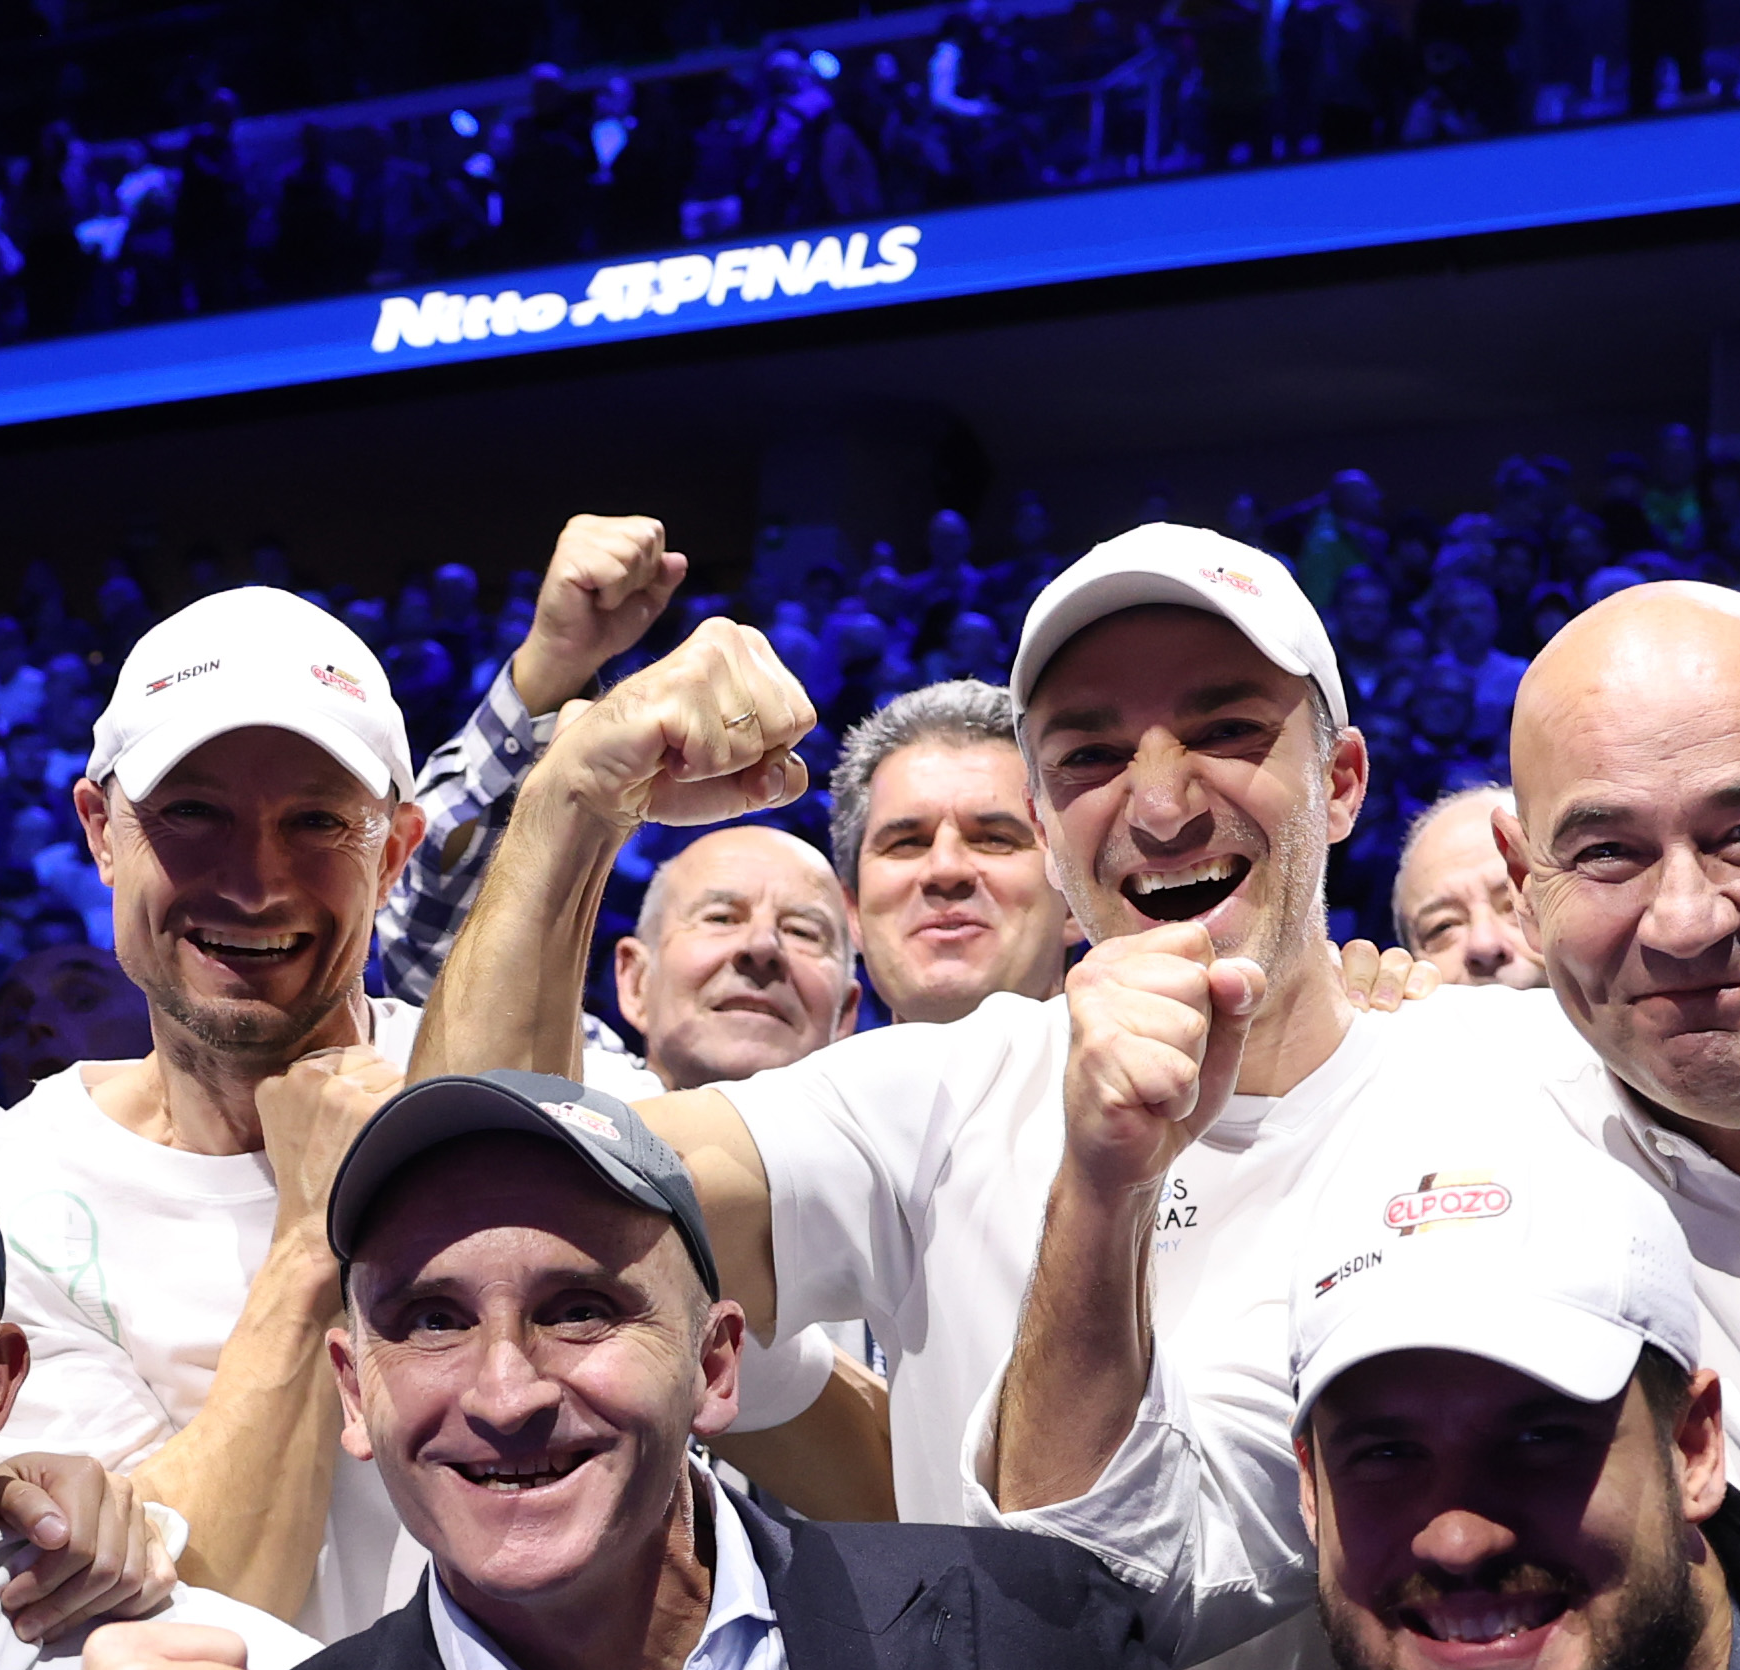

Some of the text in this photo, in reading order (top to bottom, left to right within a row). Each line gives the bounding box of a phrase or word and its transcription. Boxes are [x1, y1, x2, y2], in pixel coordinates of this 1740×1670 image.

[371, 290, 568, 353] Nitto
[177, 659, 221, 683] ISDIN
[1339, 1249, 1383, 1281] ISDIN
